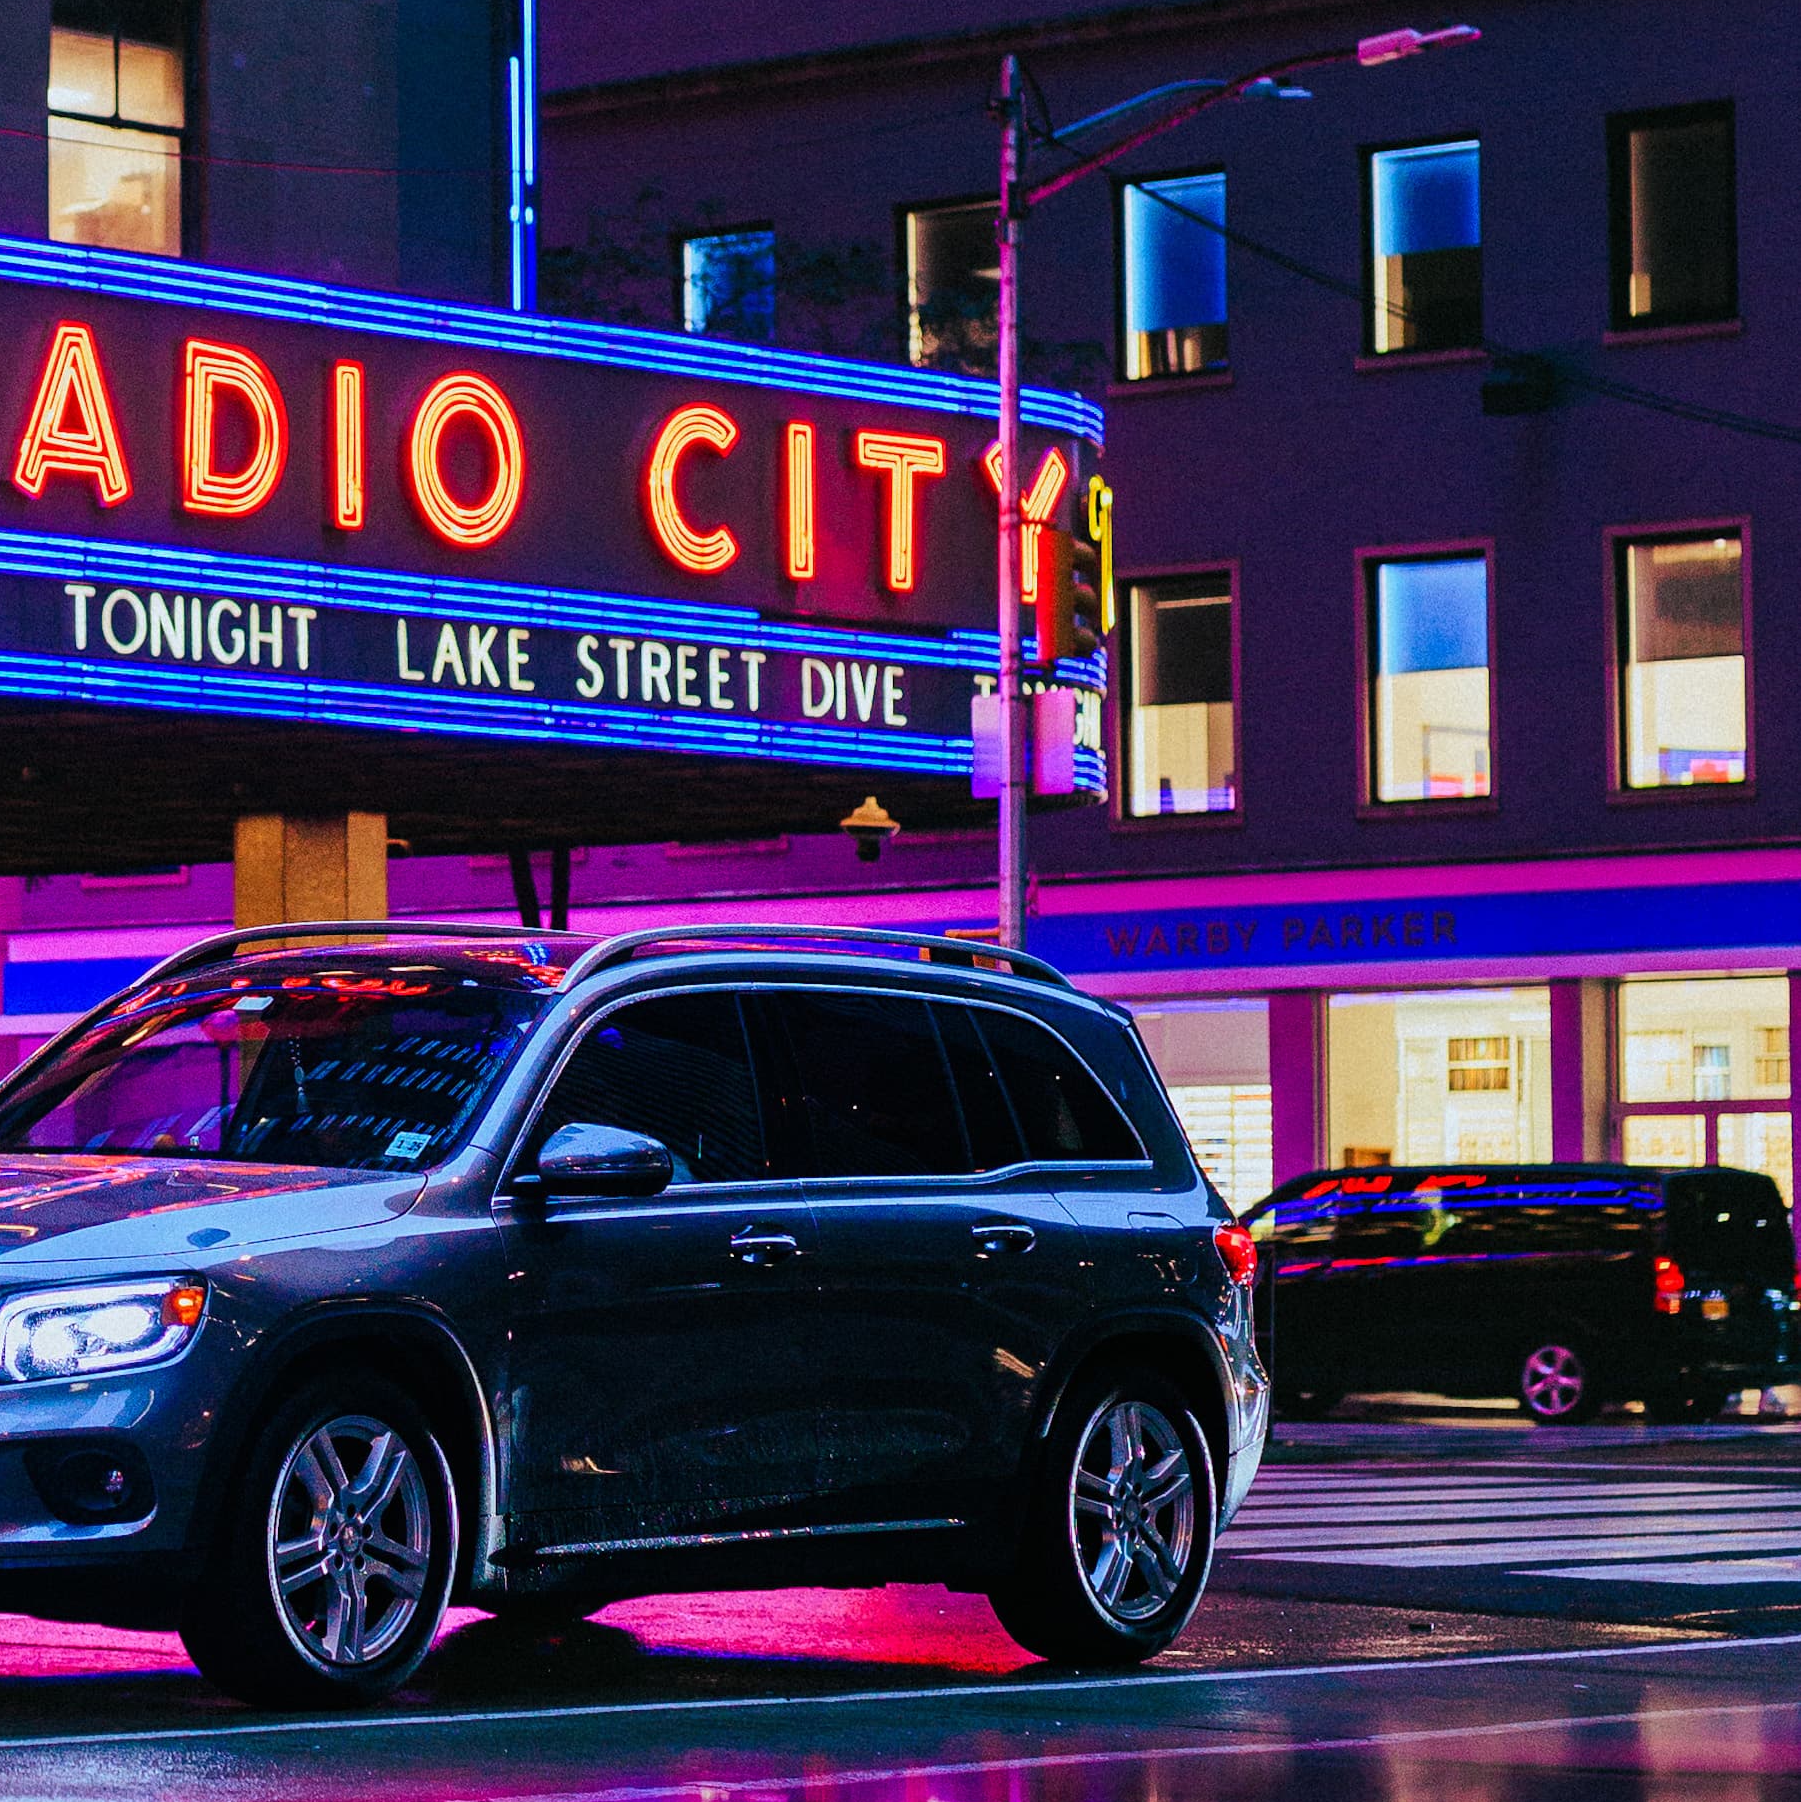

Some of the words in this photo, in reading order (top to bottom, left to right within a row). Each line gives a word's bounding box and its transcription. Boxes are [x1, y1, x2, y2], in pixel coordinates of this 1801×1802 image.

[647, 401, 1071, 605] CITY
[64, 583, 317, 671] TONIGHT
[397, 617, 535, 692] LAKE
[576, 634, 767, 713] STREET
[801, 657, 908, 728] DIVE
[1105, 920, 1258, 958] WARBY
[1281, 910, 1459, 951] PARKER
